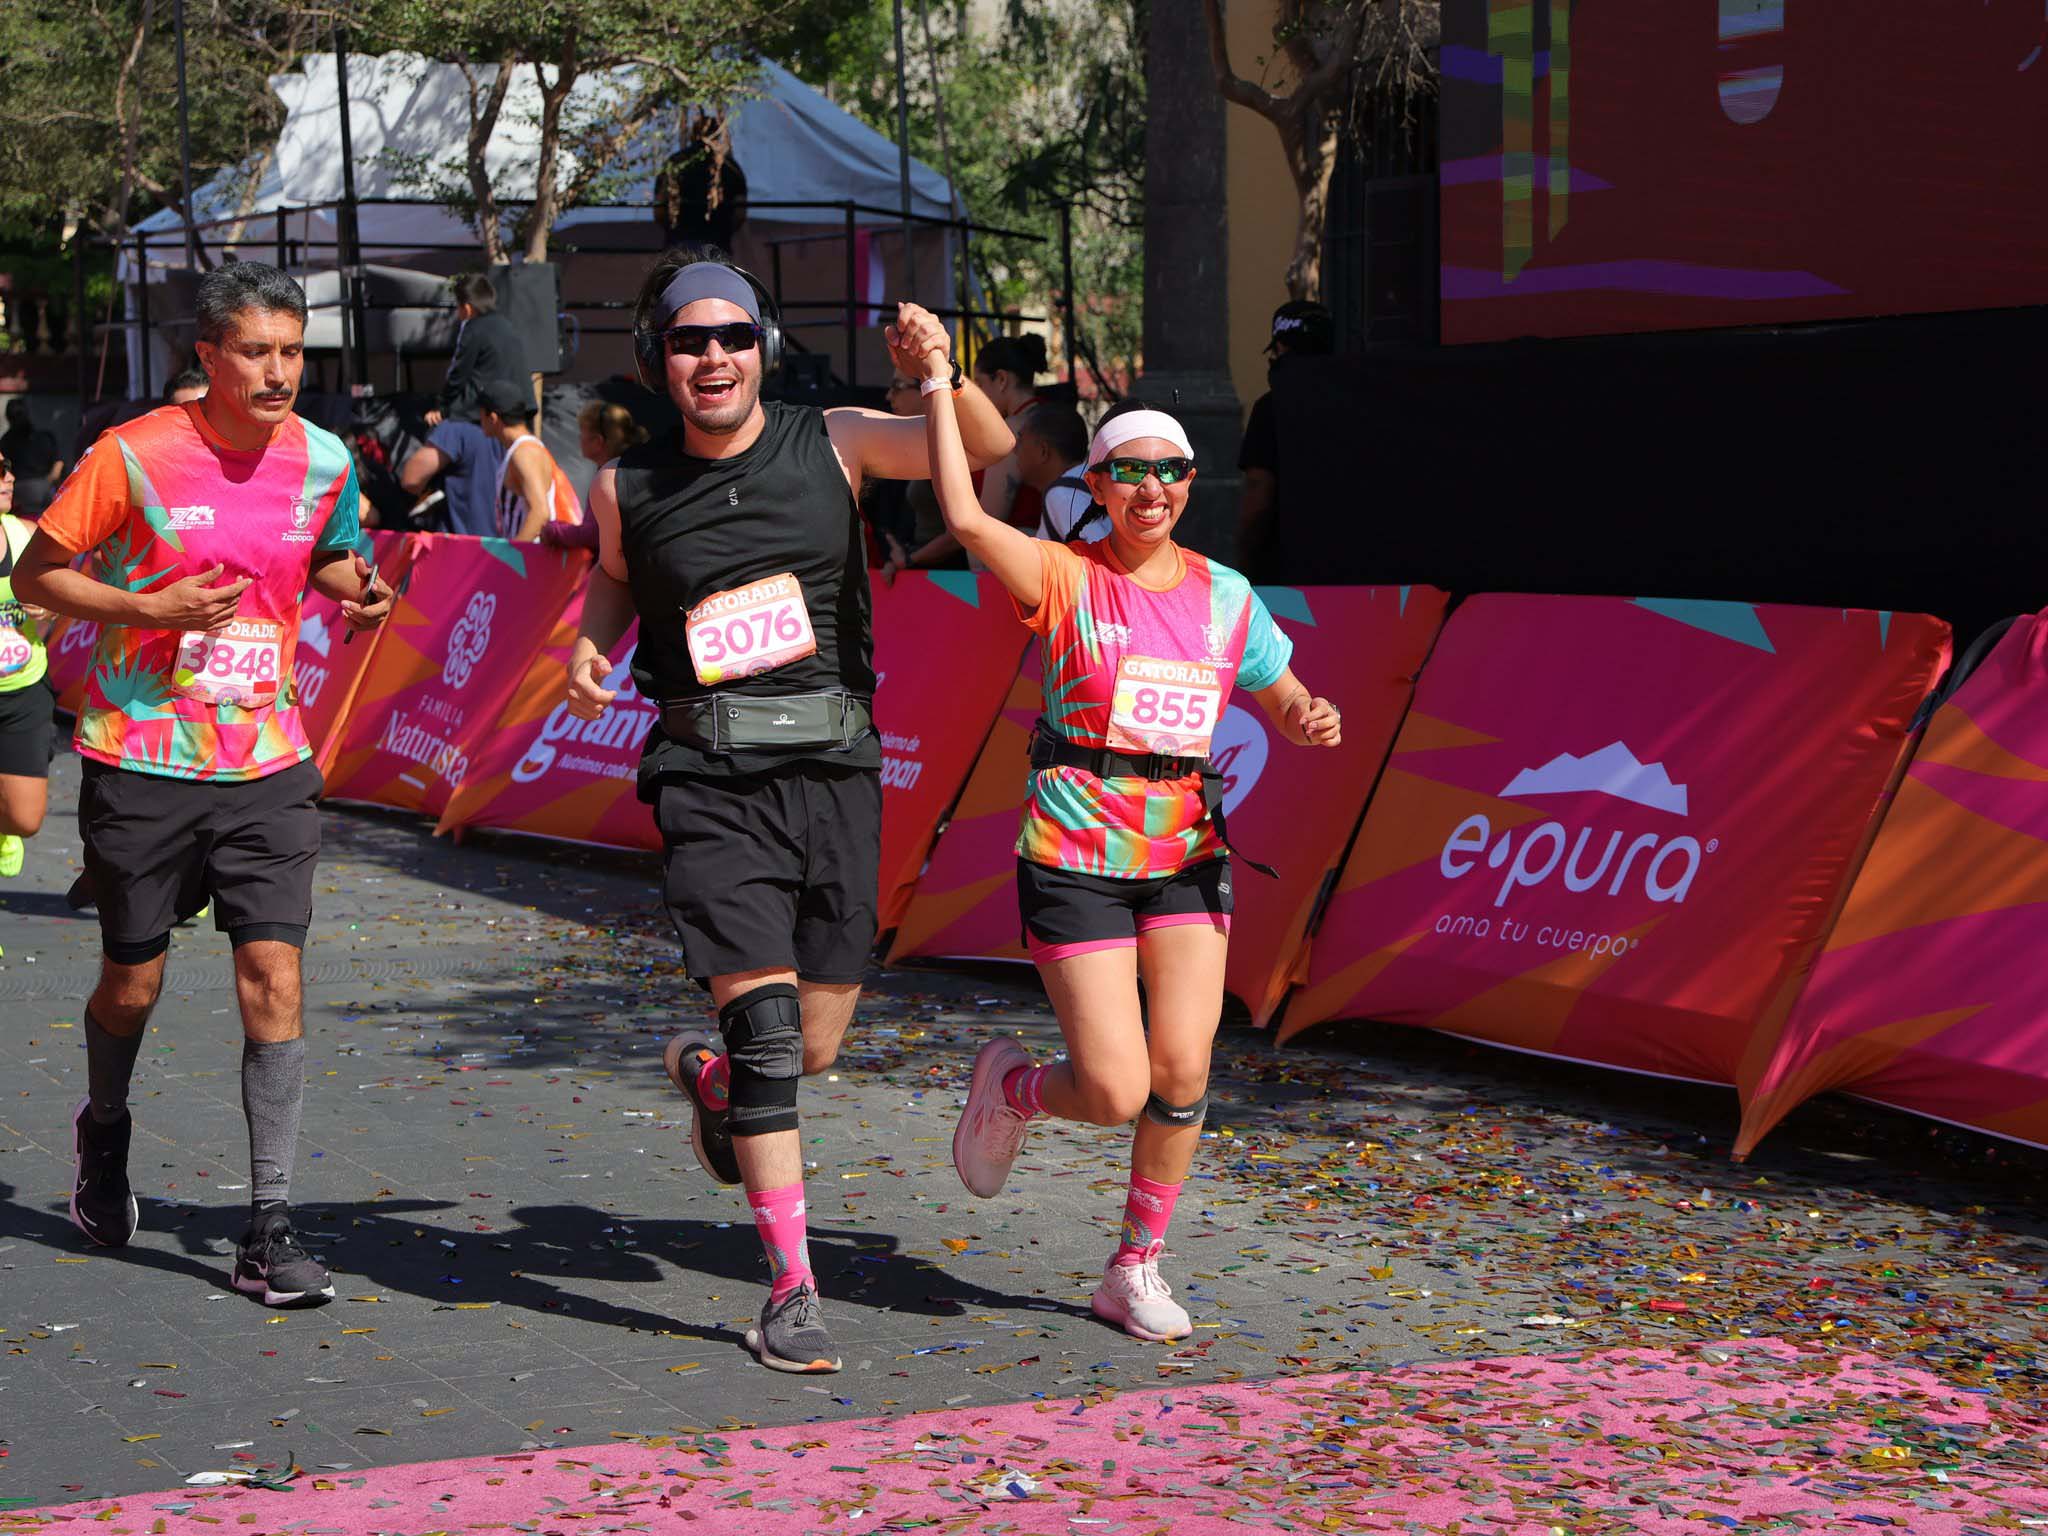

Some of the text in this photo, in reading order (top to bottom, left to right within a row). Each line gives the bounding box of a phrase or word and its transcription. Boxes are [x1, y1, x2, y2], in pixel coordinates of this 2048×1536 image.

[690, 578, 789, 622] GATORADE
[227, 621, 278, 639] ORADE
[697, 604, 802, 663] 3076
[182, 639, 275, 681] 3848
[417, 694, 463, 727] FAMILIA
[1132, 687, 1208, 730] 855
[375, 709, 470, 787] Naturista
[1436, 914, 1490, 937] ama
[1500, 917, 1529, 941] tu
